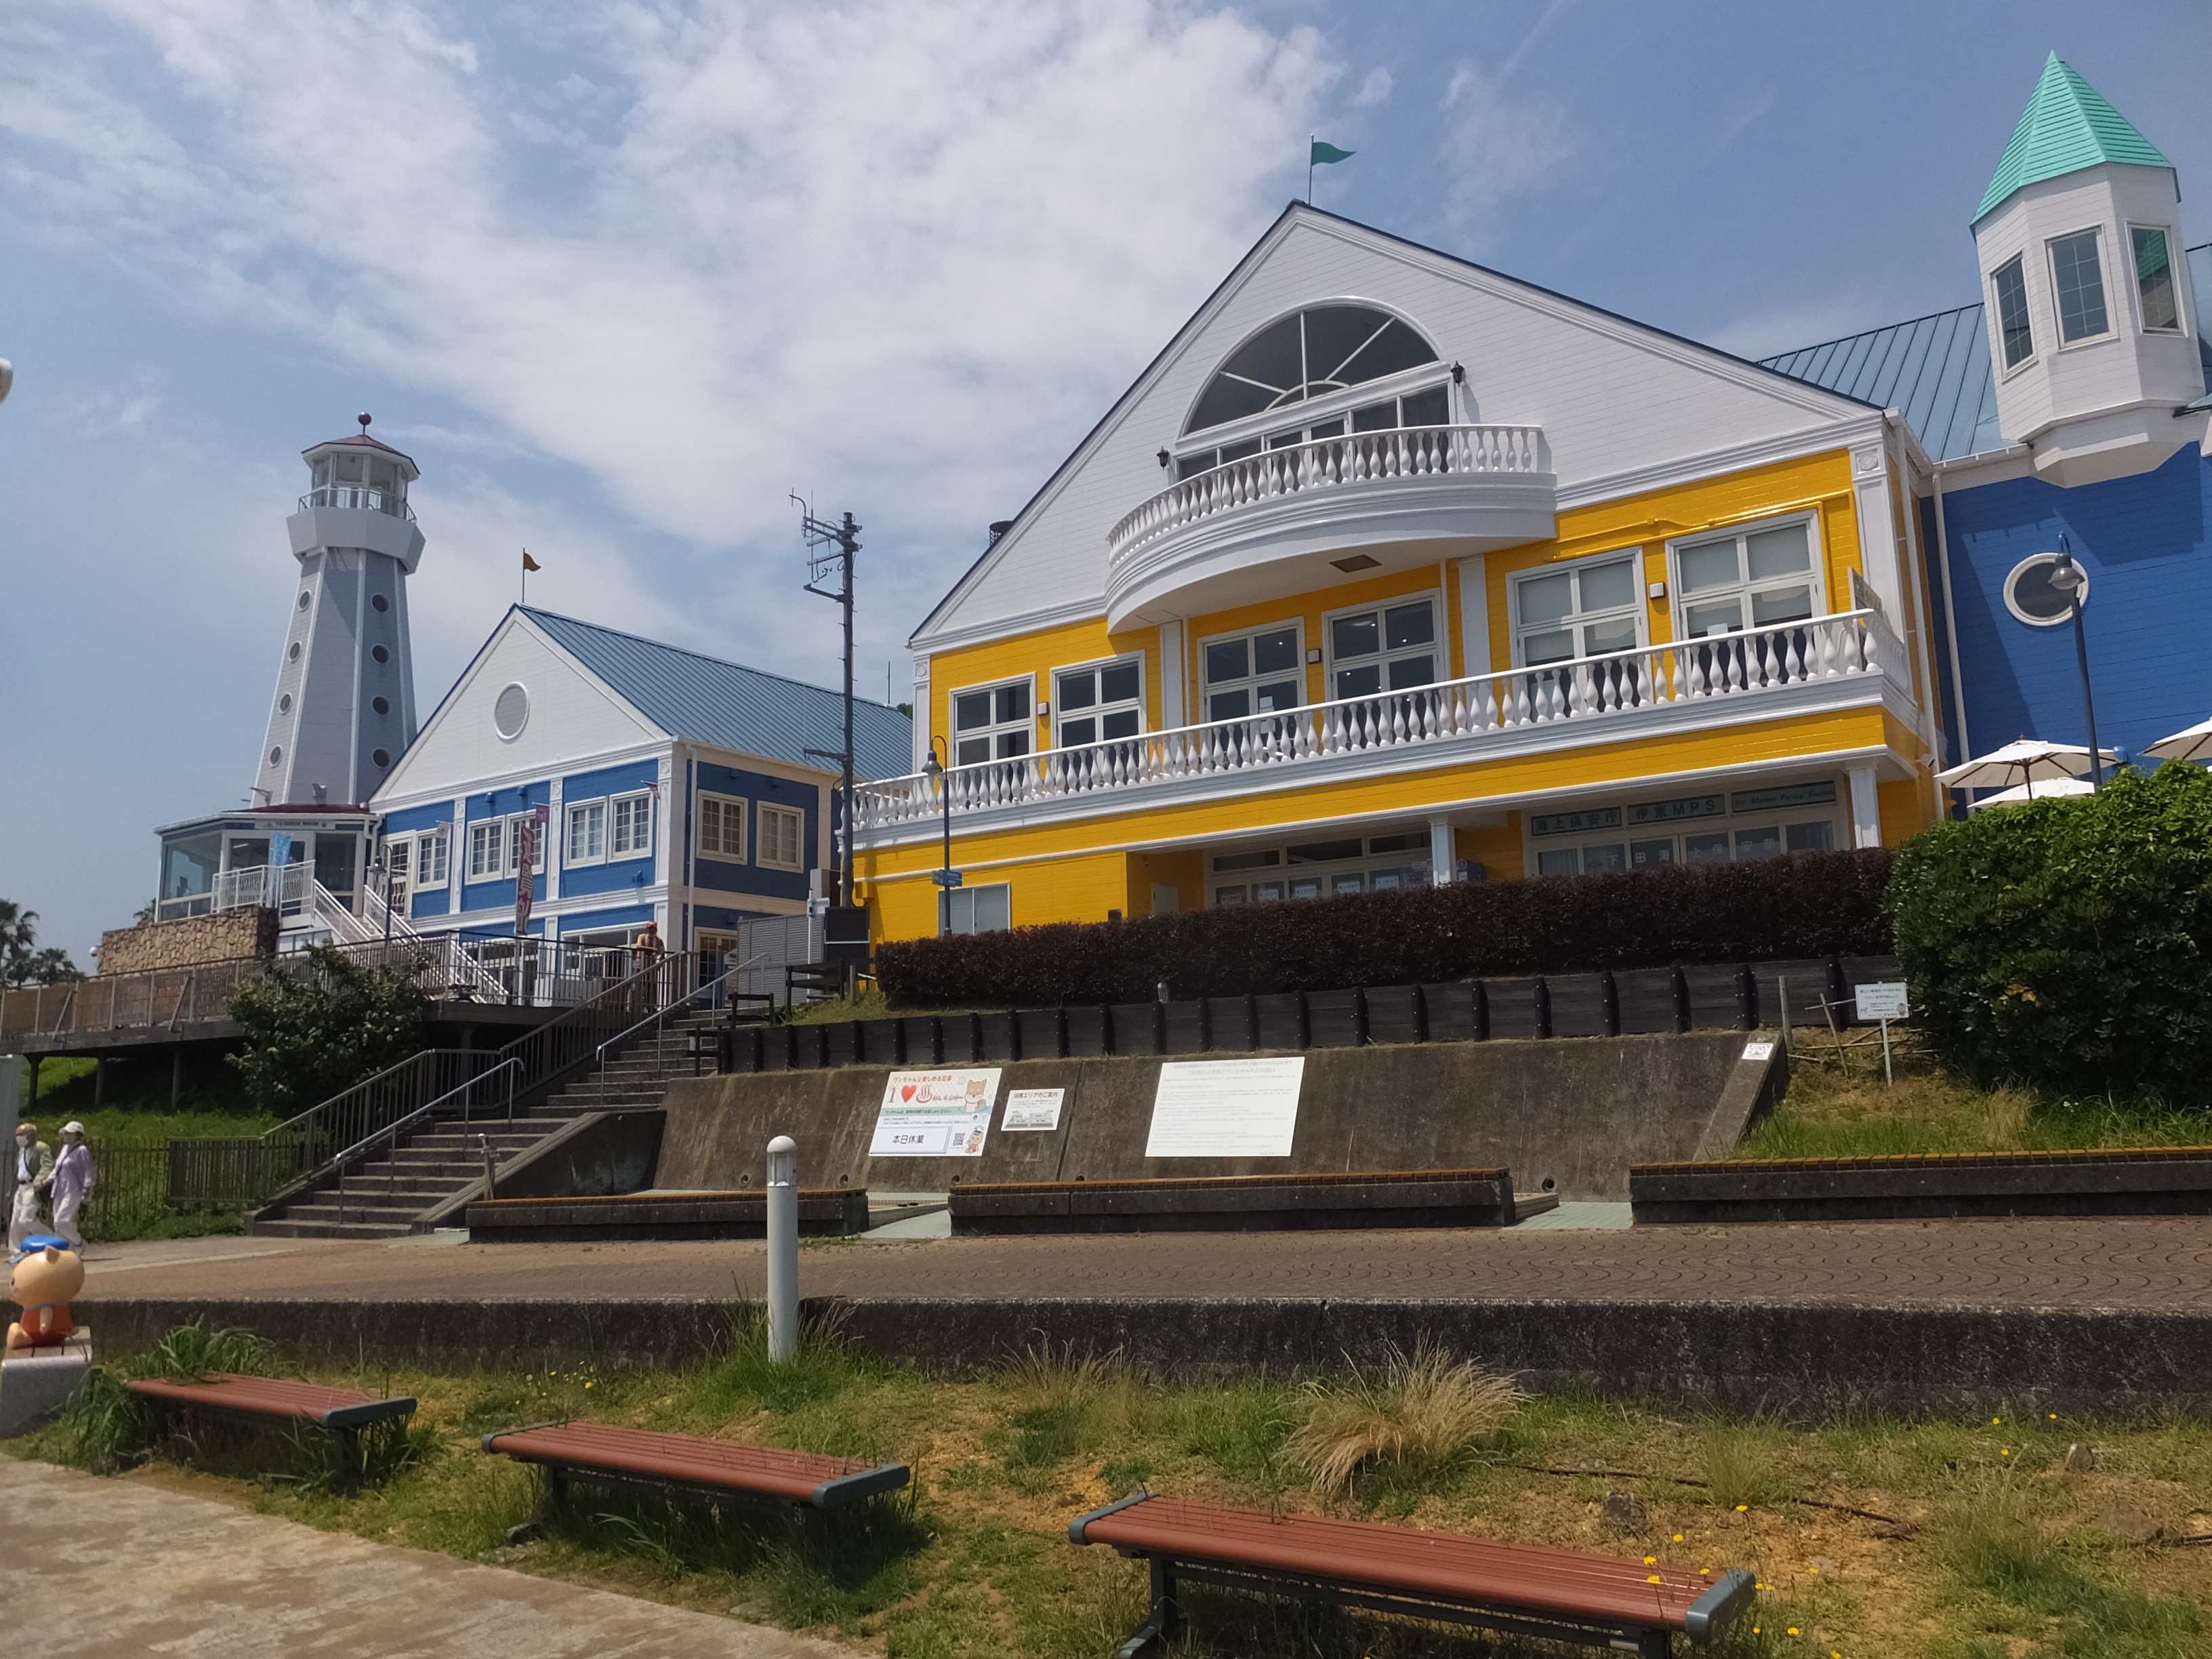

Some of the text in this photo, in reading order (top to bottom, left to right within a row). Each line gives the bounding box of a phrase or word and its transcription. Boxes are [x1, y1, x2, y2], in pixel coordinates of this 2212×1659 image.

[1635, 799, 1716, 821] 伊東MPS
[1535, 811, 1618, 832] 海上保安庁
[892, 1134, 924, 1145] 本日休業
